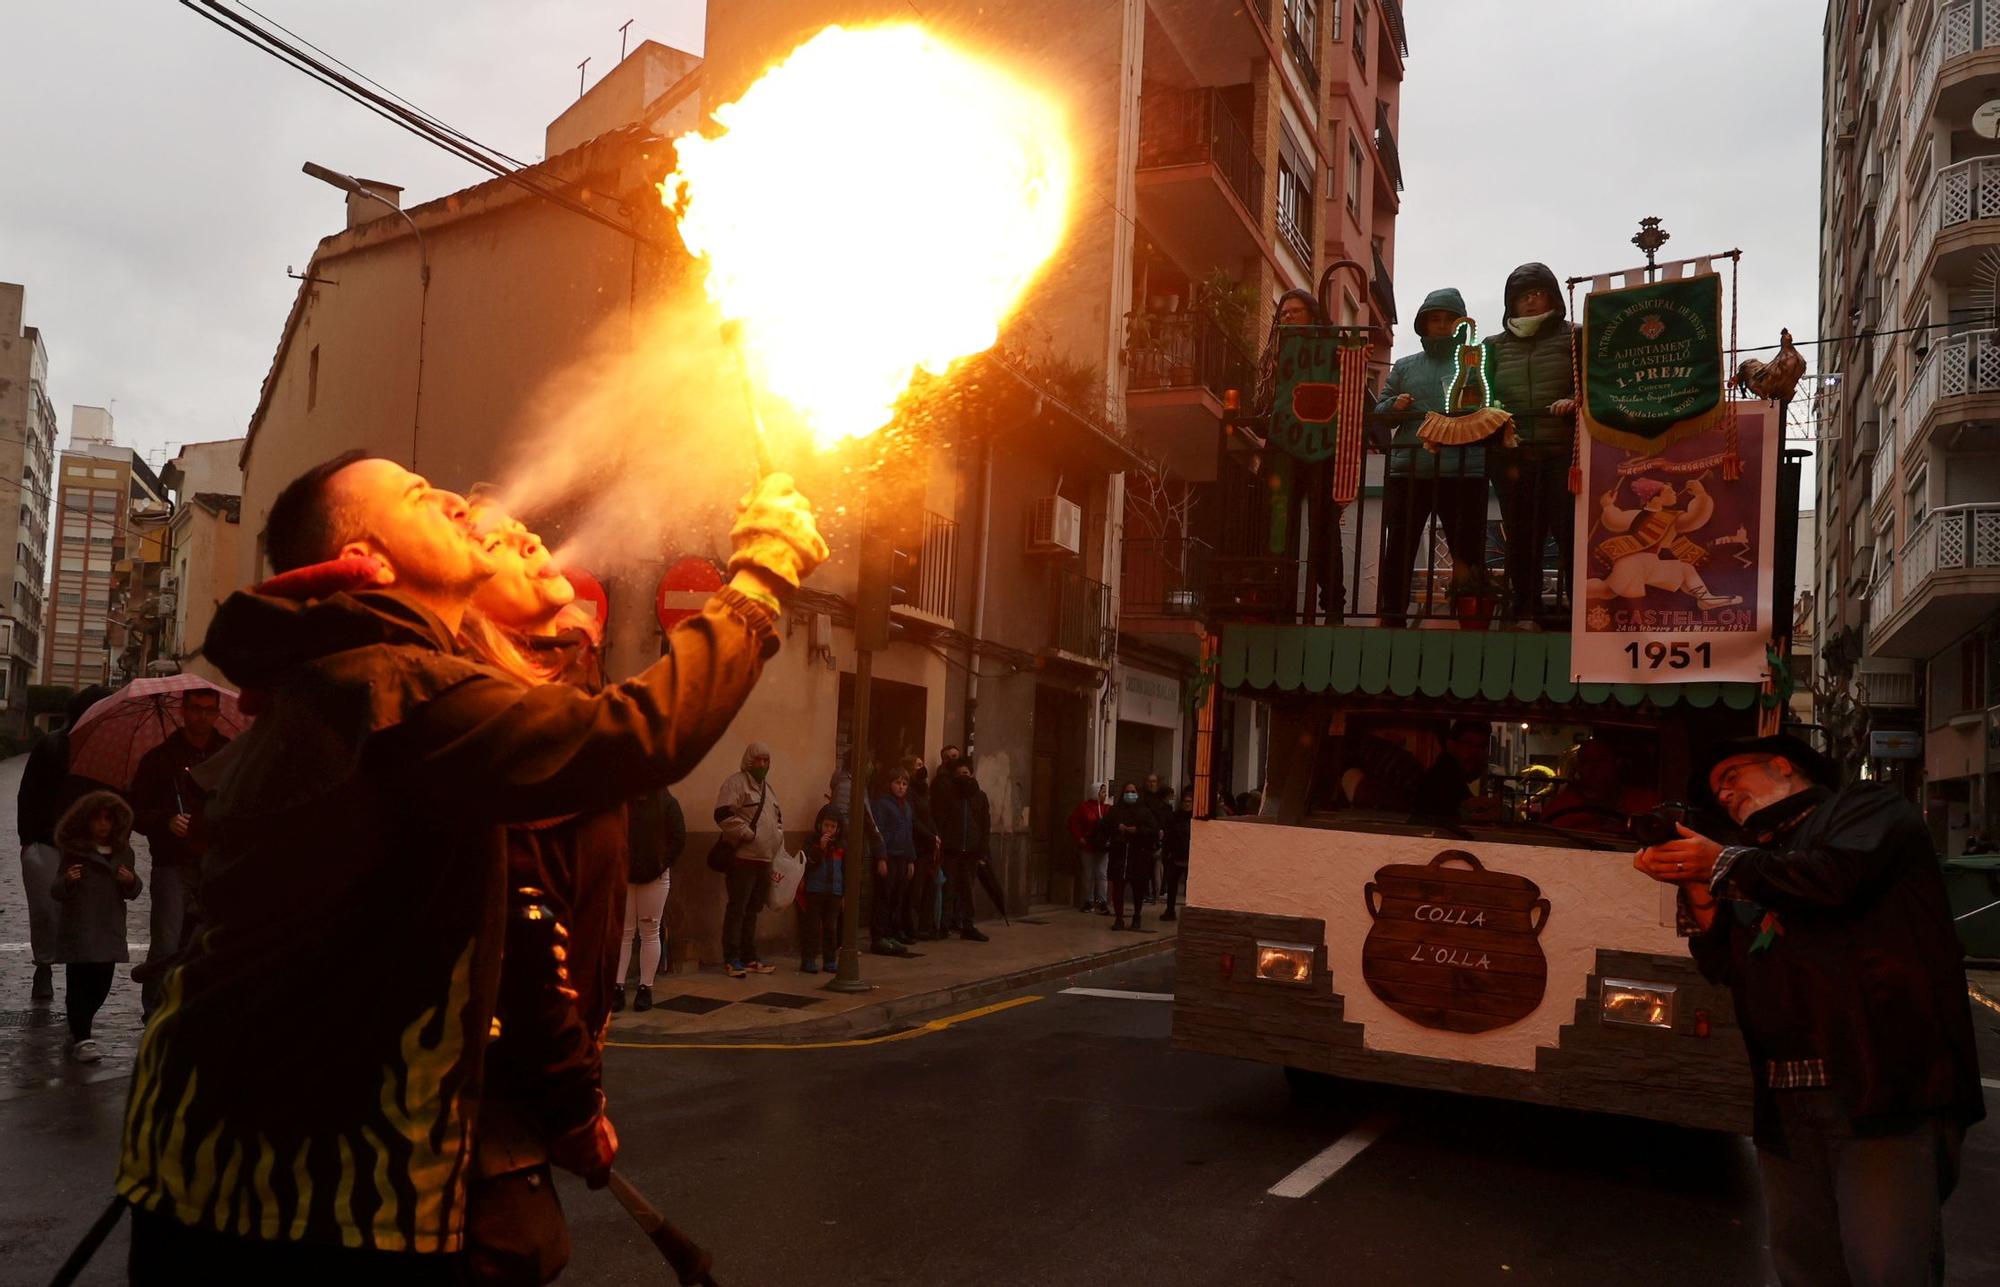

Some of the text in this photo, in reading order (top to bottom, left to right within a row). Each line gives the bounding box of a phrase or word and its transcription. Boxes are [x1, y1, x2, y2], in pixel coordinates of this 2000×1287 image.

[1598, 313, 1625, 357] PATRONAT
[1624, 299, 1675, 317] MUNICIPAL
[1615, 338, 1693, 360] AJUNTAMENT
[1617, 403, 1669, 418] Magdalena
[1624, 641, 1711, 669] 1951
[1414, 904, 1487, 927] COLLA
[1410, 945, 1491, 970] L'OLLA
